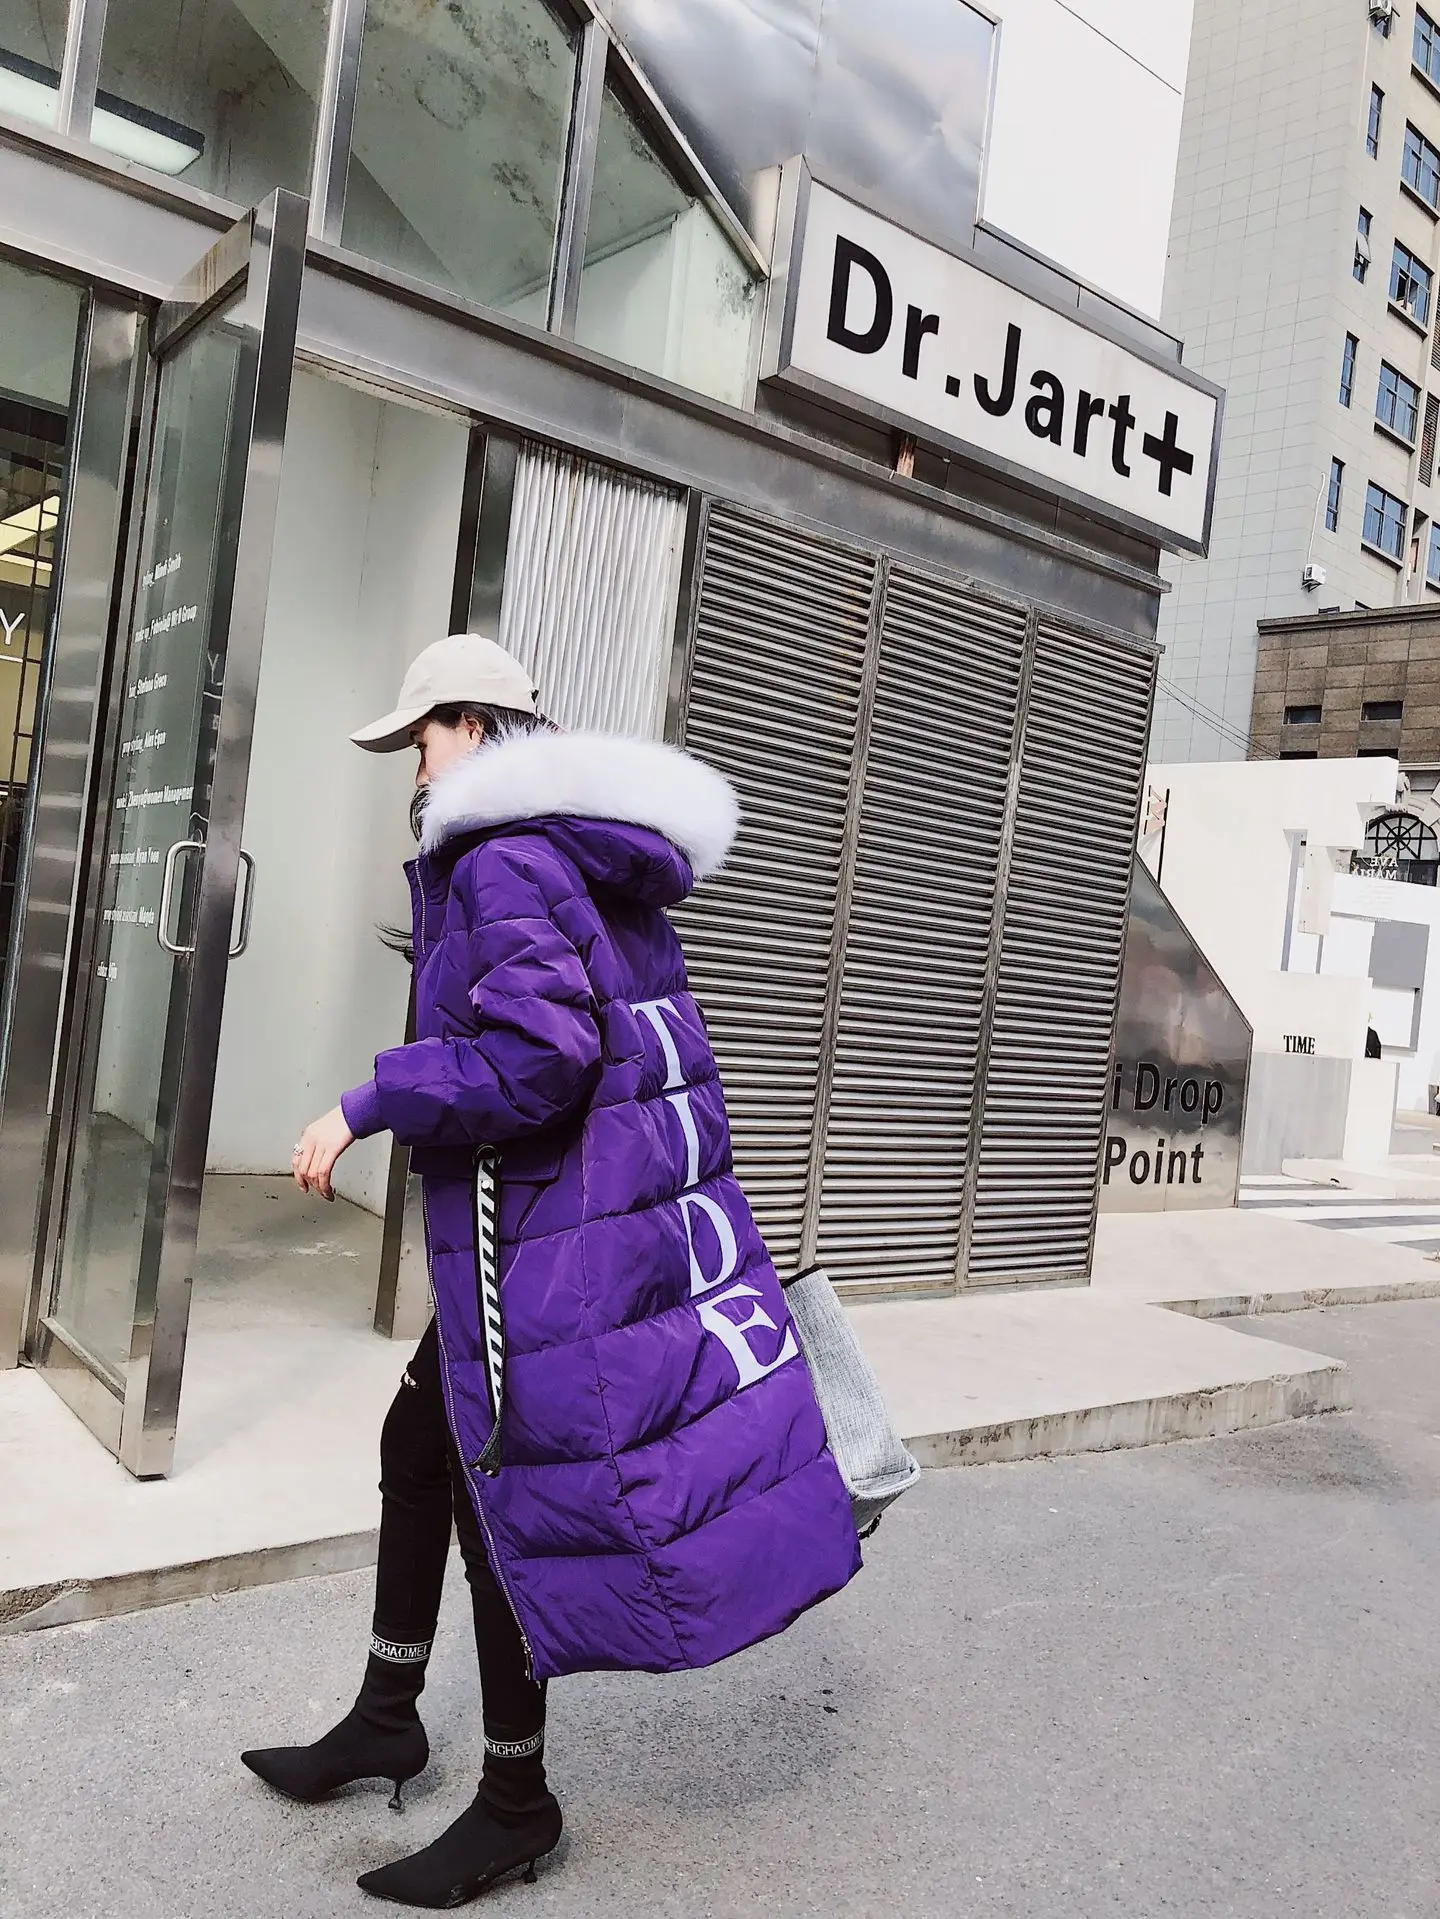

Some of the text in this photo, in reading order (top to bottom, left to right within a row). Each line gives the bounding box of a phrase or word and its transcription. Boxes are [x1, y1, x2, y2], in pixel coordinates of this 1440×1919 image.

[1283, 1034, 1315, 1055] TIME
[1133, 1062, 1224, 1124] Drop
[1102, 1136, 1204, 1185] Point
[629, 997, 799, 1391] TIDE
